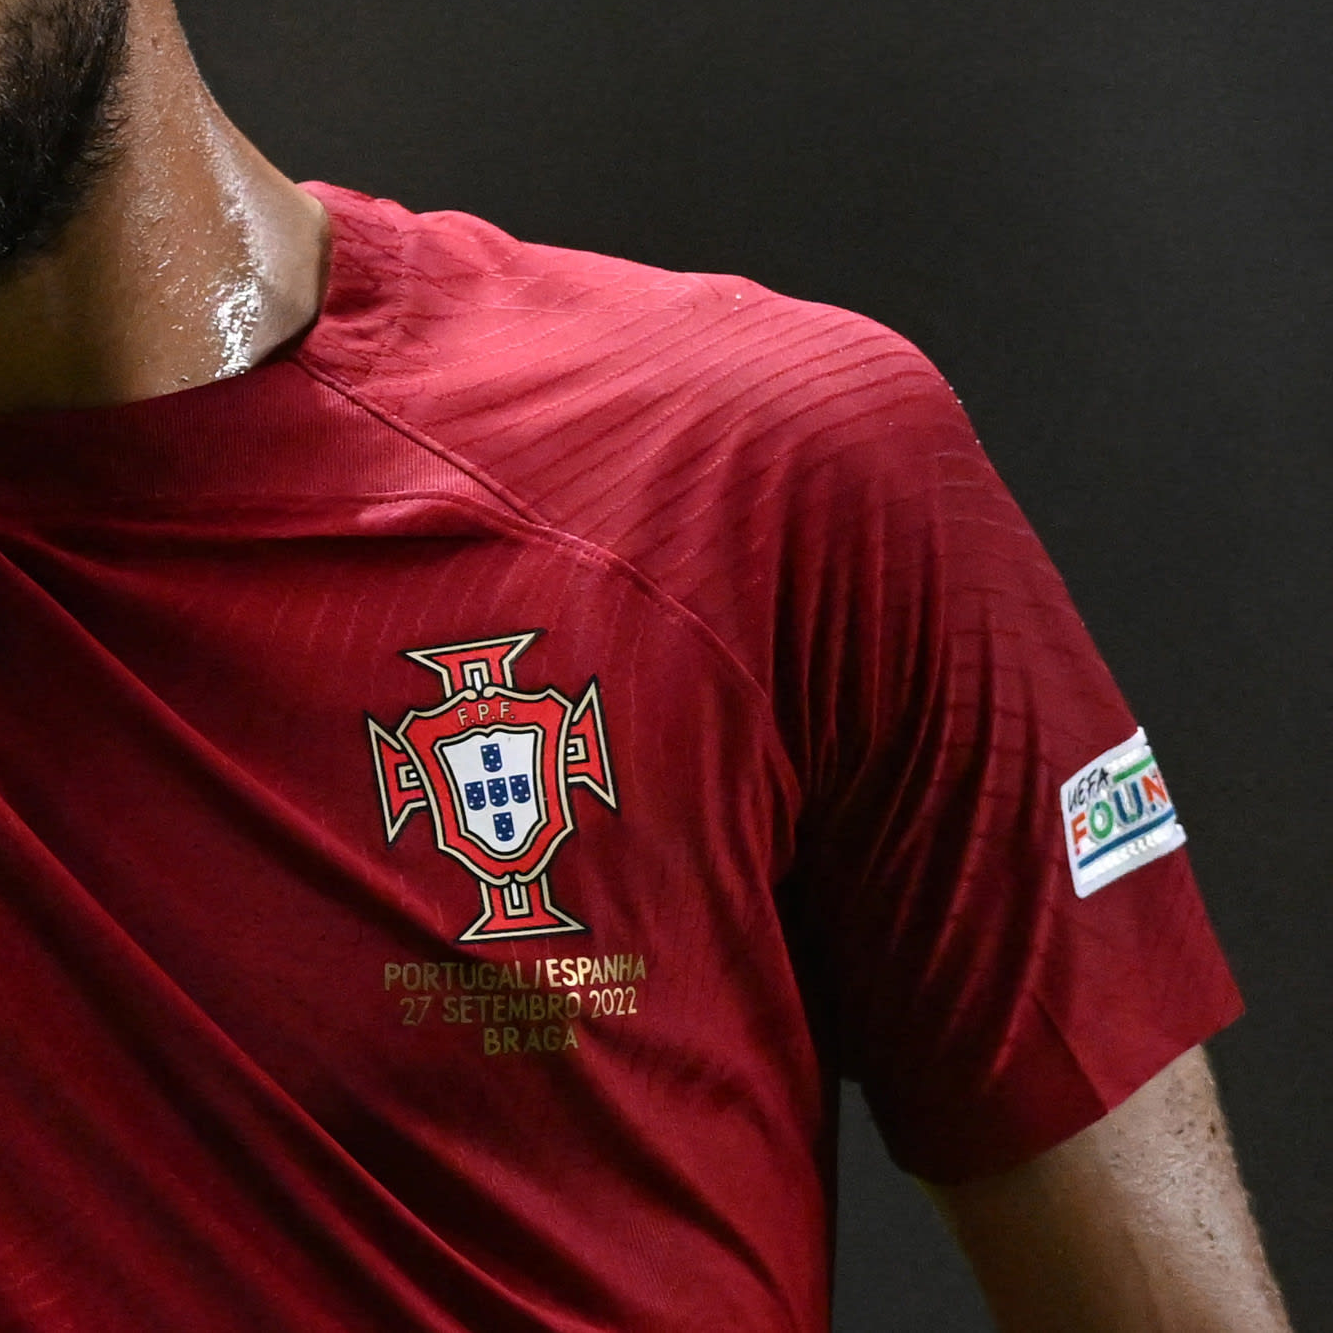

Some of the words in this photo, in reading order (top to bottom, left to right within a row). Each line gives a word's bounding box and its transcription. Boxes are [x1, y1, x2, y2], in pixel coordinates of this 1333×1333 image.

[1068, 768, 1109, 812] UEFA
[399, 996, 433, 1026] 27
[442, 991, 582, 1024] SETEMBRO
[589, 986, 638, 1018] 2022
[485, 1025, 579, 1055] BRAGA
